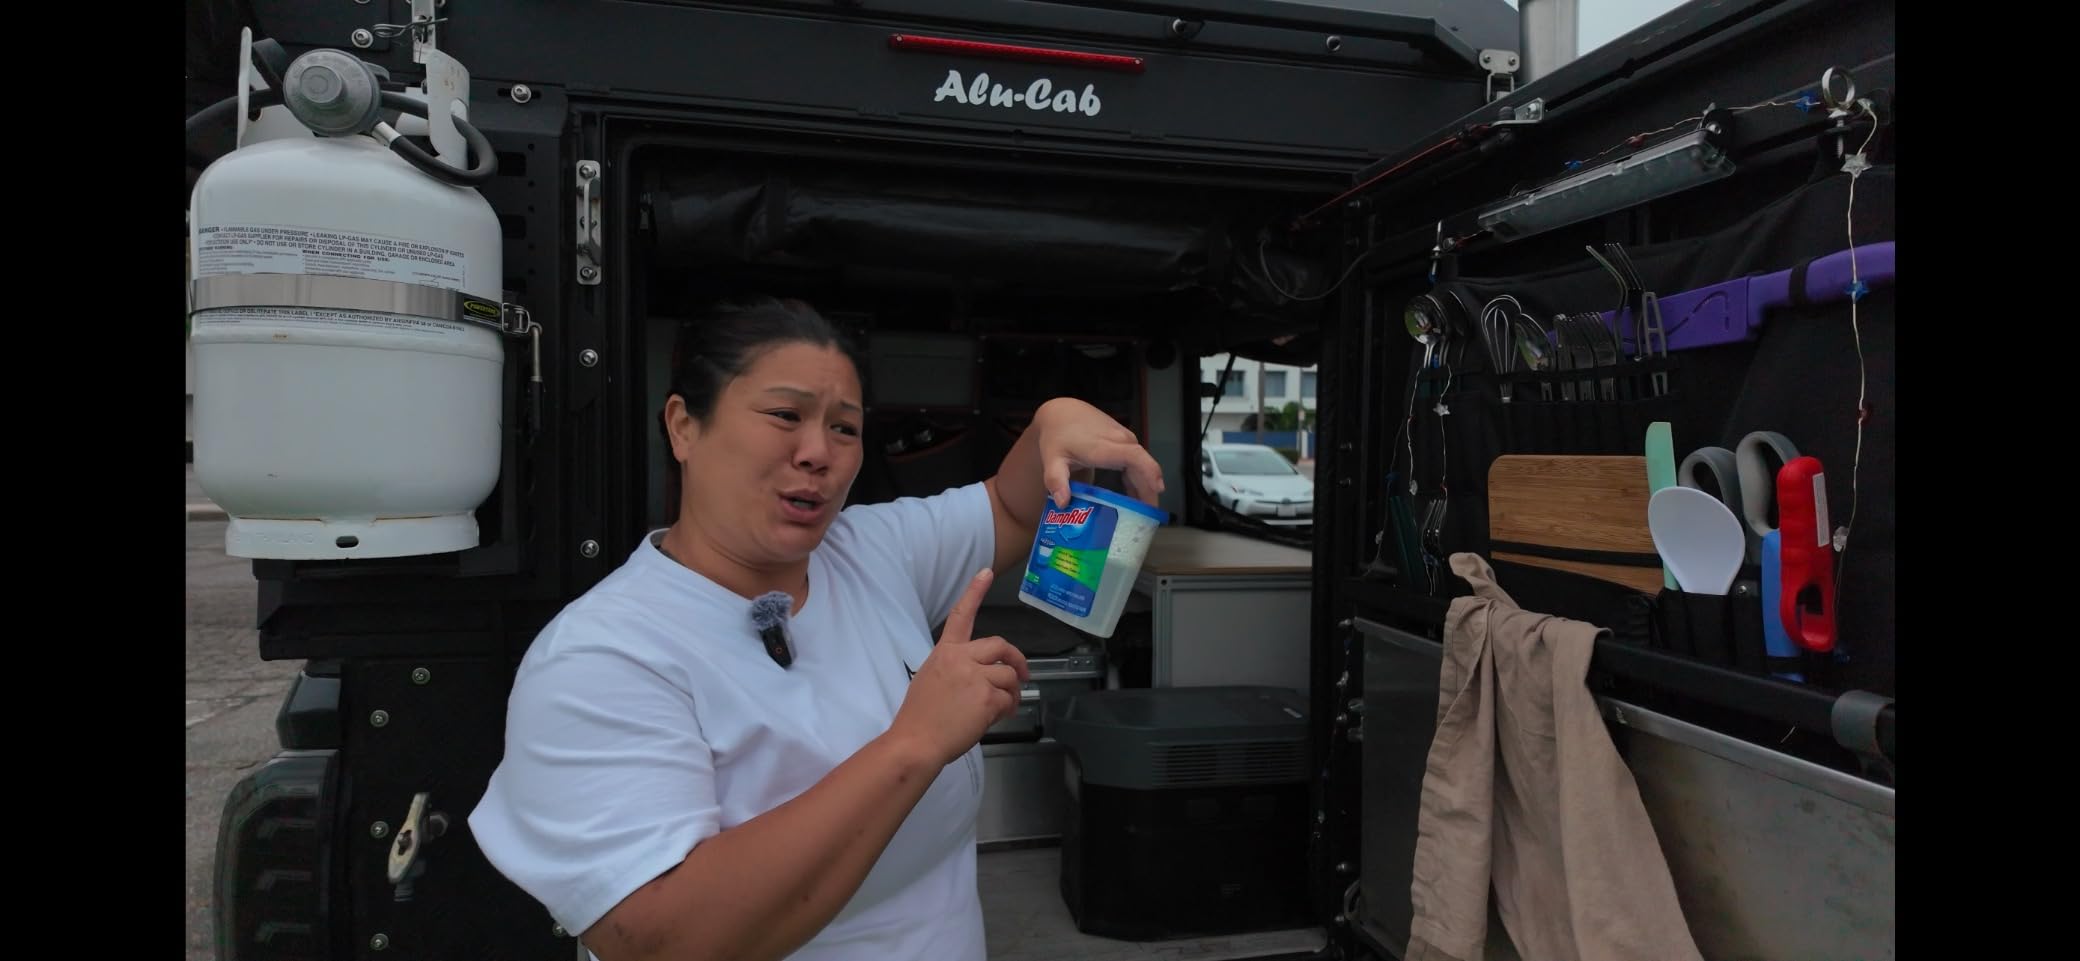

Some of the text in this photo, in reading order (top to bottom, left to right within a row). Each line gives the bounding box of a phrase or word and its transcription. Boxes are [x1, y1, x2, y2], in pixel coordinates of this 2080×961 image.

[934, 70, 1101, 116] Alu-Cab
[280, 229, 309, 237] PRESSURE
[313, 231, 337, 240] LEAKING
[374, 238, 392, 246] CAUSE
[284, 235, 308, 243] REPAIRS
[319, 238, 346, 247] DISPOSAL
[370, 244, 396, 252] CYLINDER
[317, 244, 346, 252] CYLINDER
[321, 251, 361, 259] CONNECTING
[1044, 506, 1095, 528] DampRid
